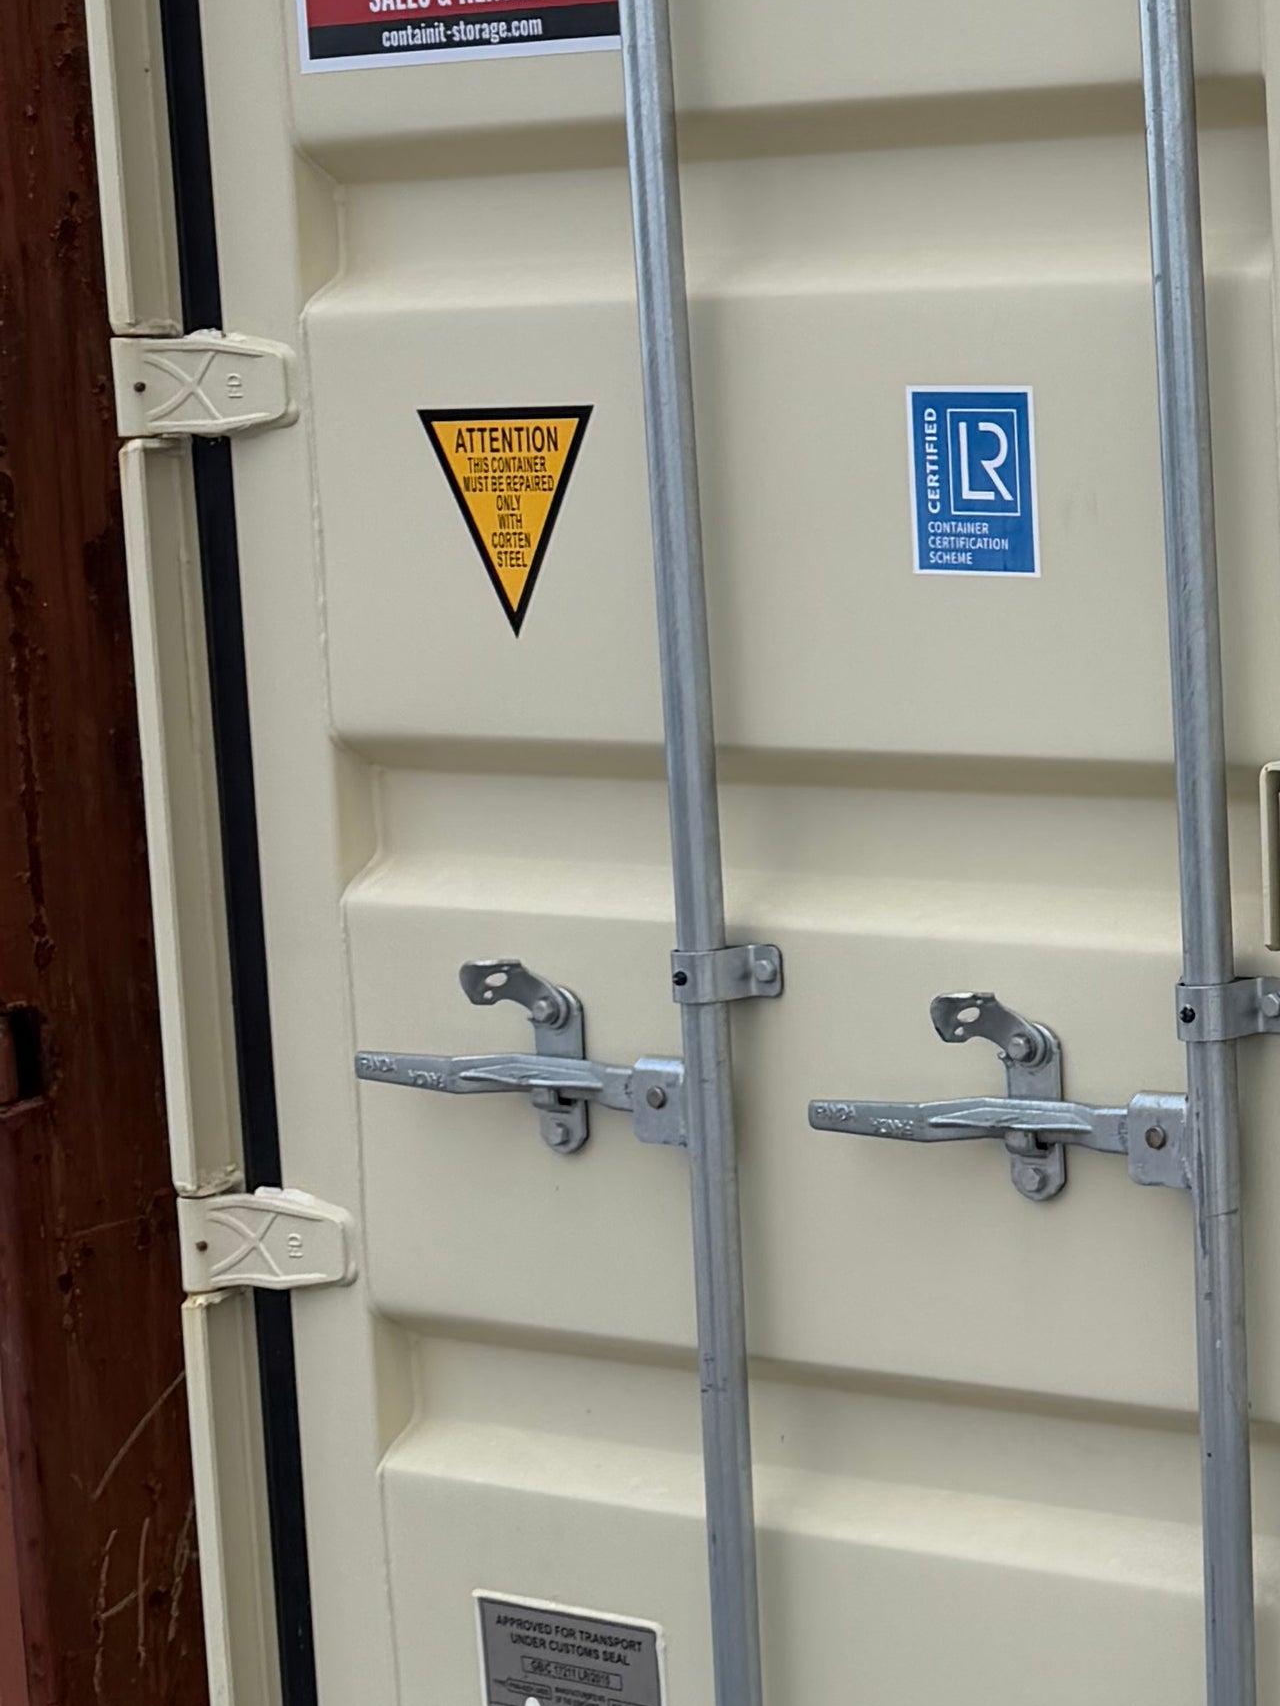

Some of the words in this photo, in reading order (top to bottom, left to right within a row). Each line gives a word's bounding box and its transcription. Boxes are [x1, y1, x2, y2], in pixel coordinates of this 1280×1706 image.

[382, 18, 543, 48] containit-storage.com
[455, 426, 559, 453] ATTENTION
[467, 457, 489, 473] THIS
[491, 456, 547, 473] CONTAINER
[924, 407, 941, 514] CERTIFIED
[958, 421, 1014, 501] LR
[463, 476, 489, 492] MUST
[491, 476, 504, 492] BE
[506, 475, 554, 492] REPAIRED
[496, 495, 521, 511] ONLY
[498, 514, 523, 529] WITH
[928, 521, 989, 535] CONTAINER
[491, 532, 531, 548] CORTEN
[928, 536, 1009, 550] CERTIFICATION
[496, 551, 528, 568] STEEL
[929, 551, 973, 565] SCHEME
[496, 1615, 553, 1635] APPROVED
[555, 1626, 577, 1641] FOR
[579, 1631, 643, 1653] TRANSPORT
[510, 1633, 546, 1649] UNDER
[549, 1640, 600, 1660] CUSTOMS
[602, 1651, 631, 1666] SEAL
